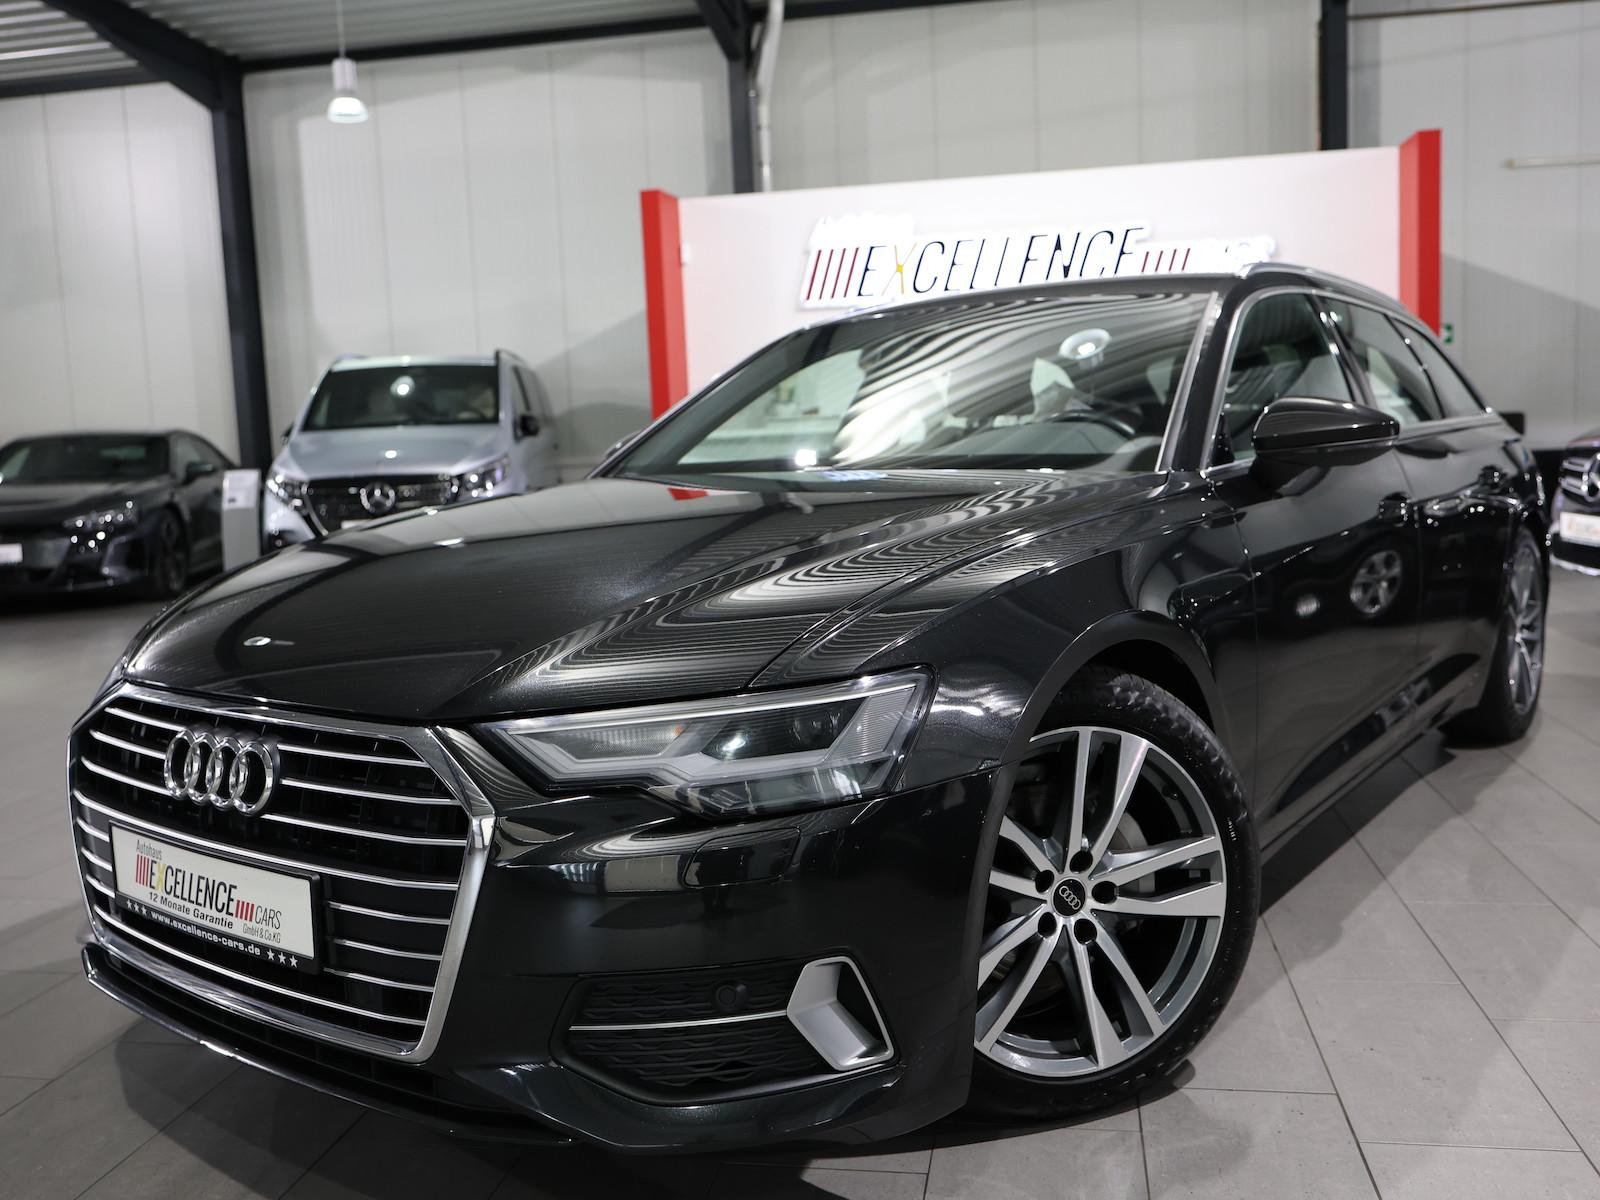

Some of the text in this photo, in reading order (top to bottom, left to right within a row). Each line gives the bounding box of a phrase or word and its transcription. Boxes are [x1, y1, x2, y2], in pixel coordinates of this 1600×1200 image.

[856, 226, 1144, 298] EXCELLENCE
[136, 839, 163, 861] Autohaus
[149, 859, 282, 930] EXCELLENCE CARS
[149, 892, 234, 930] 12 Monate Garantie
[150, 910, 261, 956] www.excellence-cars.de
